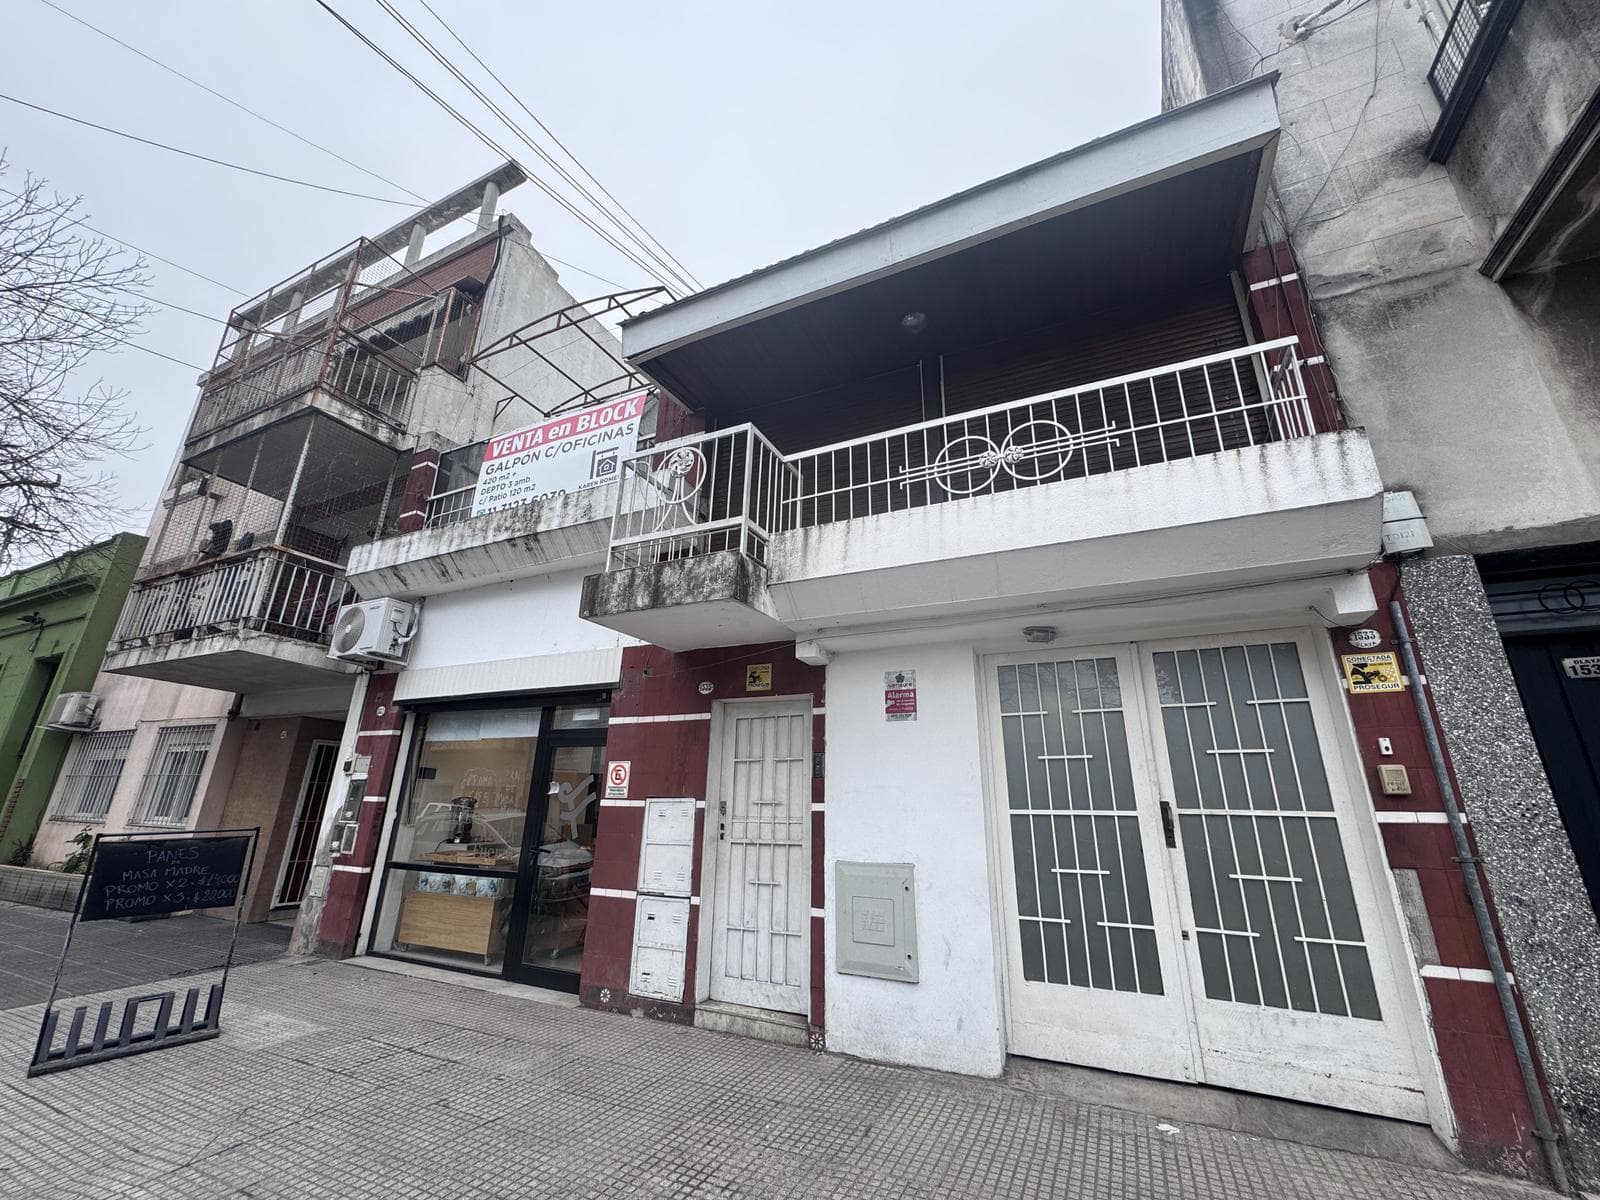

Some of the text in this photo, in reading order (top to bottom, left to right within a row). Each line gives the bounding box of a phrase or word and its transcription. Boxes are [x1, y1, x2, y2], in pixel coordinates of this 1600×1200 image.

[492, 399, 637, 458] VENTA en BLOCK
[485, 422, 634, 475] GALPÓN C/OFICINAS
[480, 476, 531, 496] DEPTO 3 amb
[482, 476, 498, 486] 420
[499, 471, 511, 481] m2
[578, 475, 619, 490] KAREN ROME
[489, 490, 508, 503] Patio
[509, 487, 522, 497] 120
[523, 483, 536, 494] m2
[1353, 631, 1376, 641] 1533
[1346, 654, 1392, 662] CONECTADA
[887, 691, 915, 699] Alarma
[146, 846, 200, 864] PANES
[122, 865, 209, 881] MASA MADRE
[104, 880, 158, 897] PROMO
[103, 894, 157, 911] PROMO
